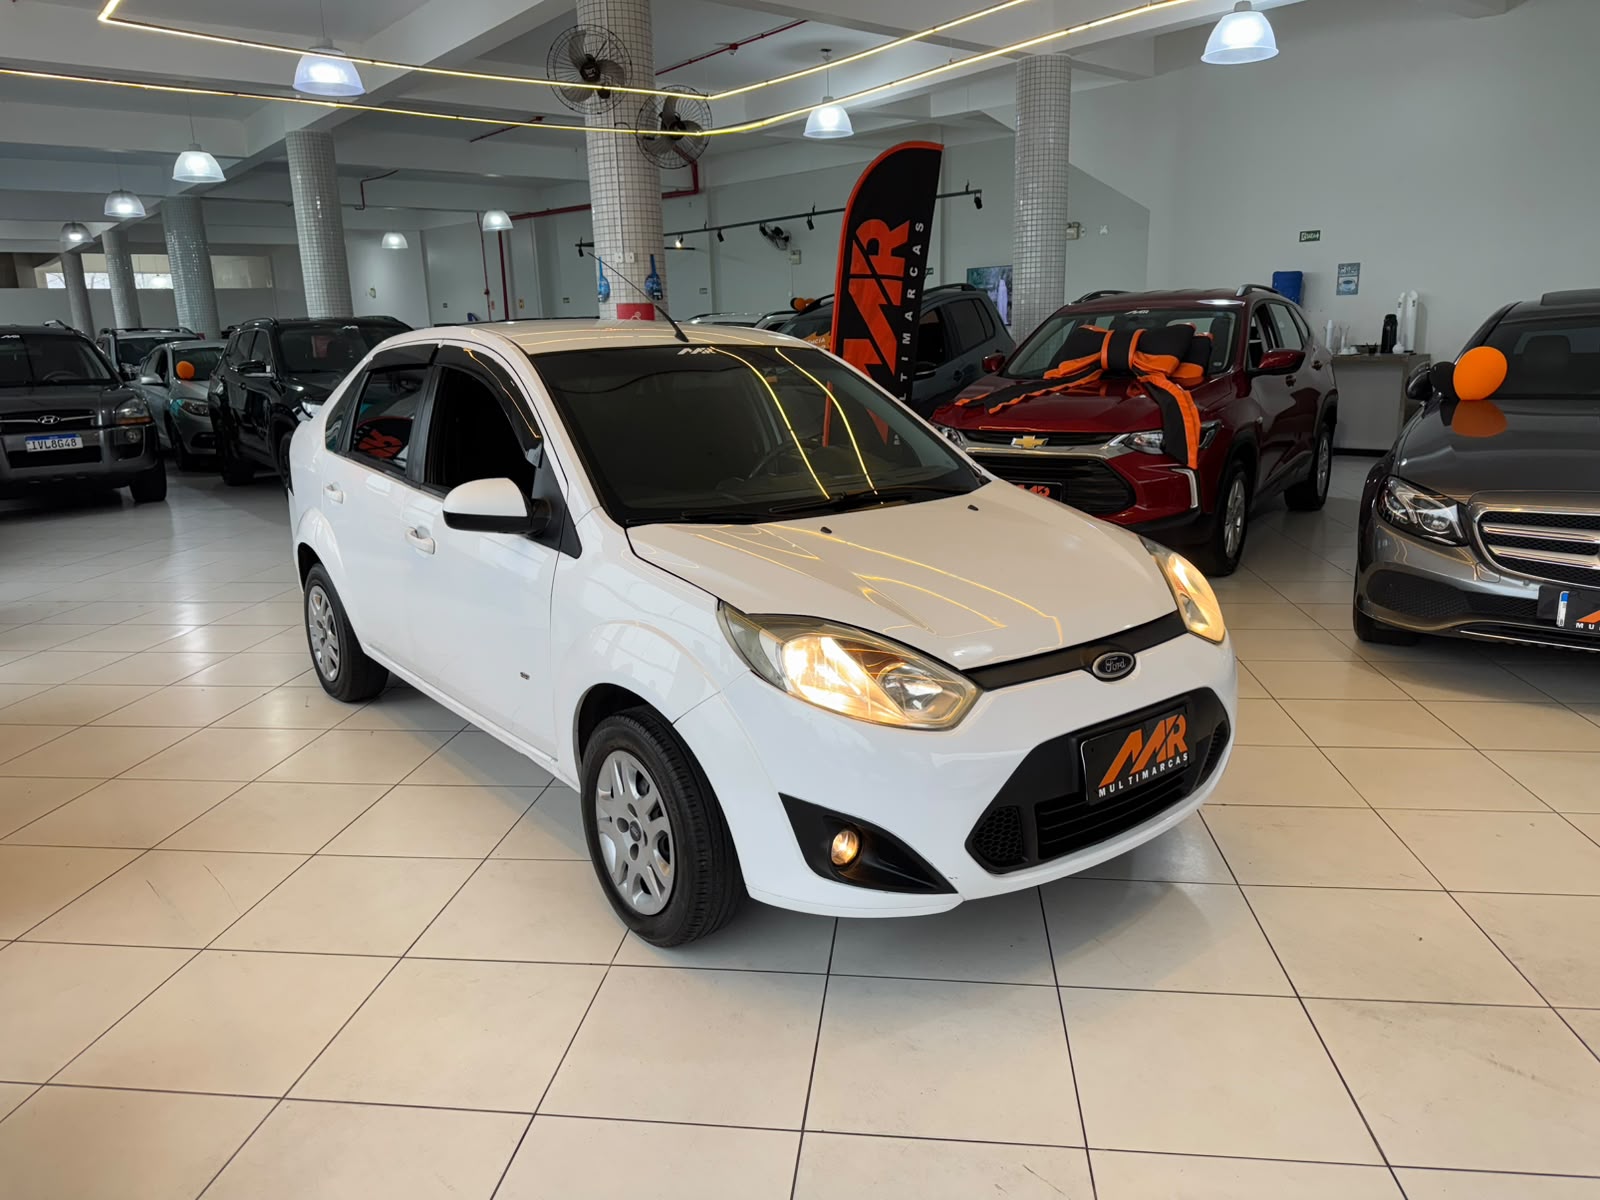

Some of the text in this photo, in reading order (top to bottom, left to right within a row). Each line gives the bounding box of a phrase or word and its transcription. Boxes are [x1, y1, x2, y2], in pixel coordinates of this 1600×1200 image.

[898, 221, 925, 402] LTIMARCAS
[32, 438, 77, 450] IVL8G48
[1104, 656, 1127, 674] Ford
[1098, 752, 1189, 798] MULTIMARCAS
